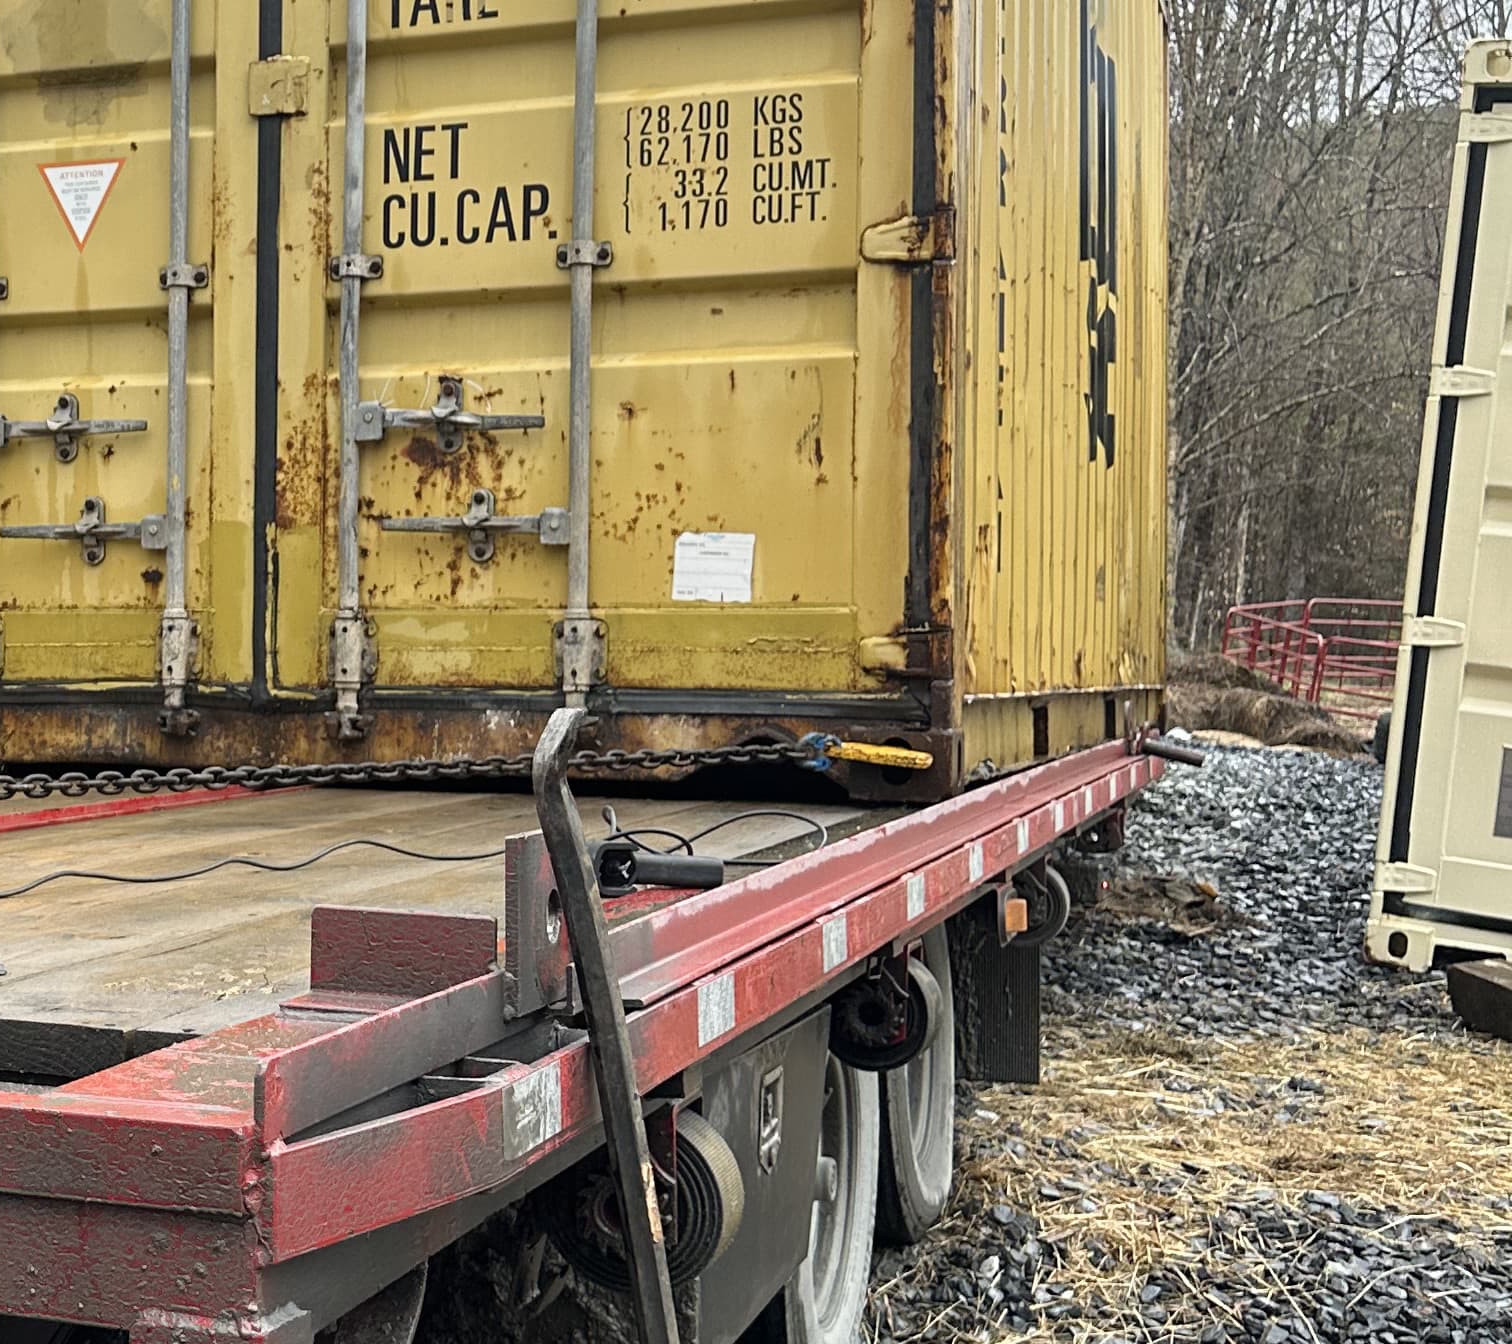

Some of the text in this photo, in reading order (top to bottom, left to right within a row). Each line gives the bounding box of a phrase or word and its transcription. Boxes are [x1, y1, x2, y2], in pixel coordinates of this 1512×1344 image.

[383, 93, 804, 185] NET 28,200 KGS
[640, 125, 803, 167] 62,170 LBS
[60, 169, 104, 180] ATTENTION
[673, 158, 837, 199] 33.2 CU.MT.
[383, 184, 557, 249] CU.CAP.
[753, 191, 827, 225] CU.FT.
